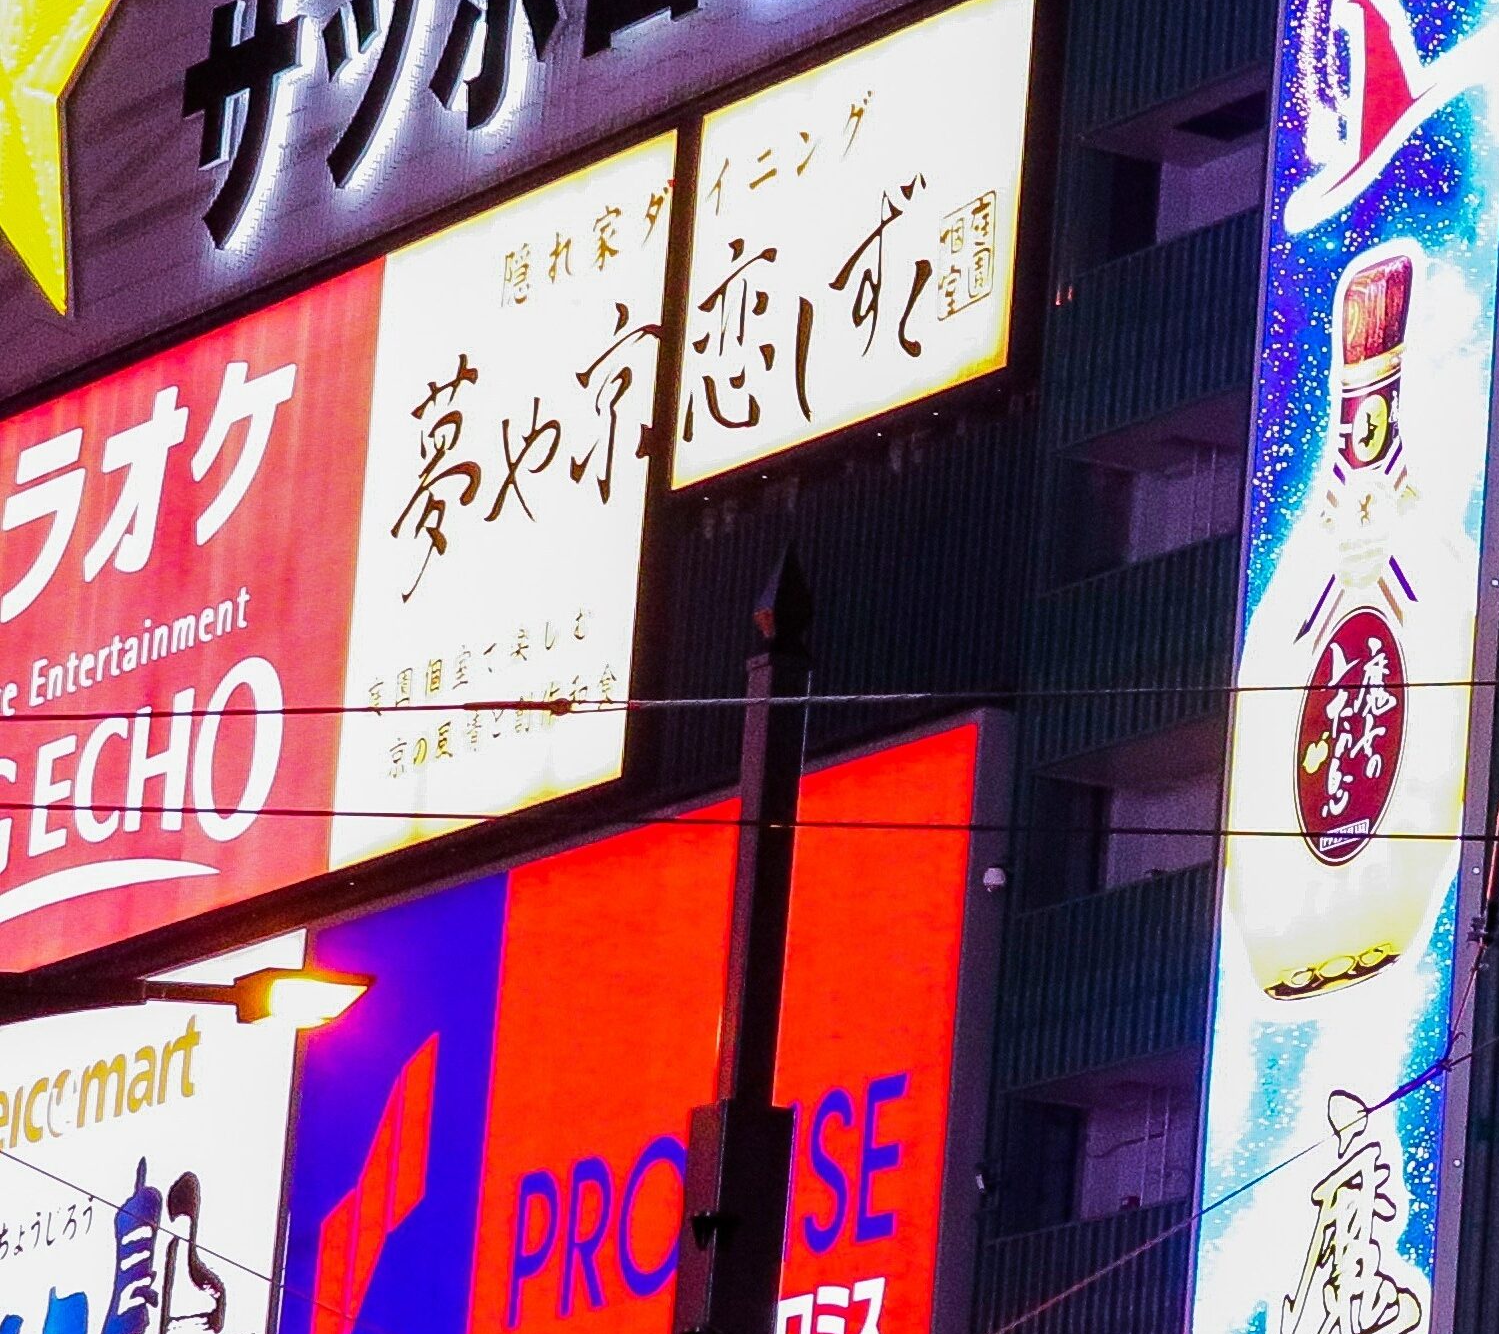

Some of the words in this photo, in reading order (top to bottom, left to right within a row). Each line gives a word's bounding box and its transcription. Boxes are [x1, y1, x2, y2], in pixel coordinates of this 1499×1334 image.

[2, 358, 298, 625] ラオケ
[27, 654, 285, 859] ECHO
[32, 585, 250, 699] Entertainment
[507, 1073, 908, 1331] PROSE
